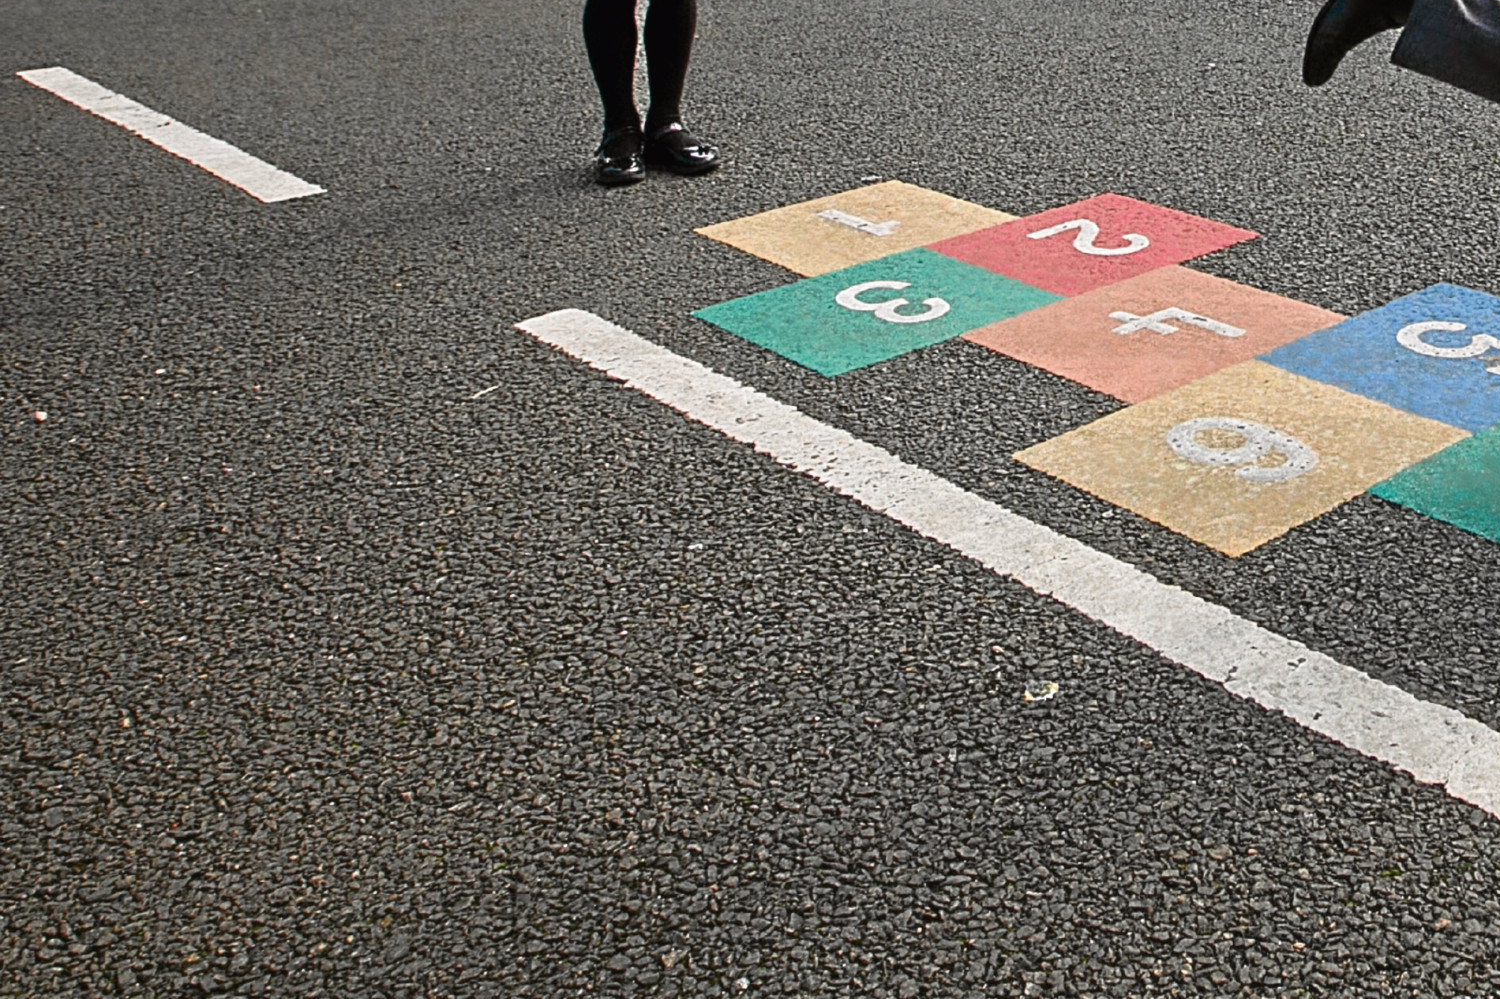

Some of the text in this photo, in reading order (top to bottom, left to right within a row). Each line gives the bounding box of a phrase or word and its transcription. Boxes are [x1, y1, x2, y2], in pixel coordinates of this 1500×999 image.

[816, 207, 901, 238] 1
[1027, 219, 1149, 256] 2
[835, 280, 951, 323] 3
[1108, 307, 1246, 338] 4
[1166, 416, 1319, 484] 6
